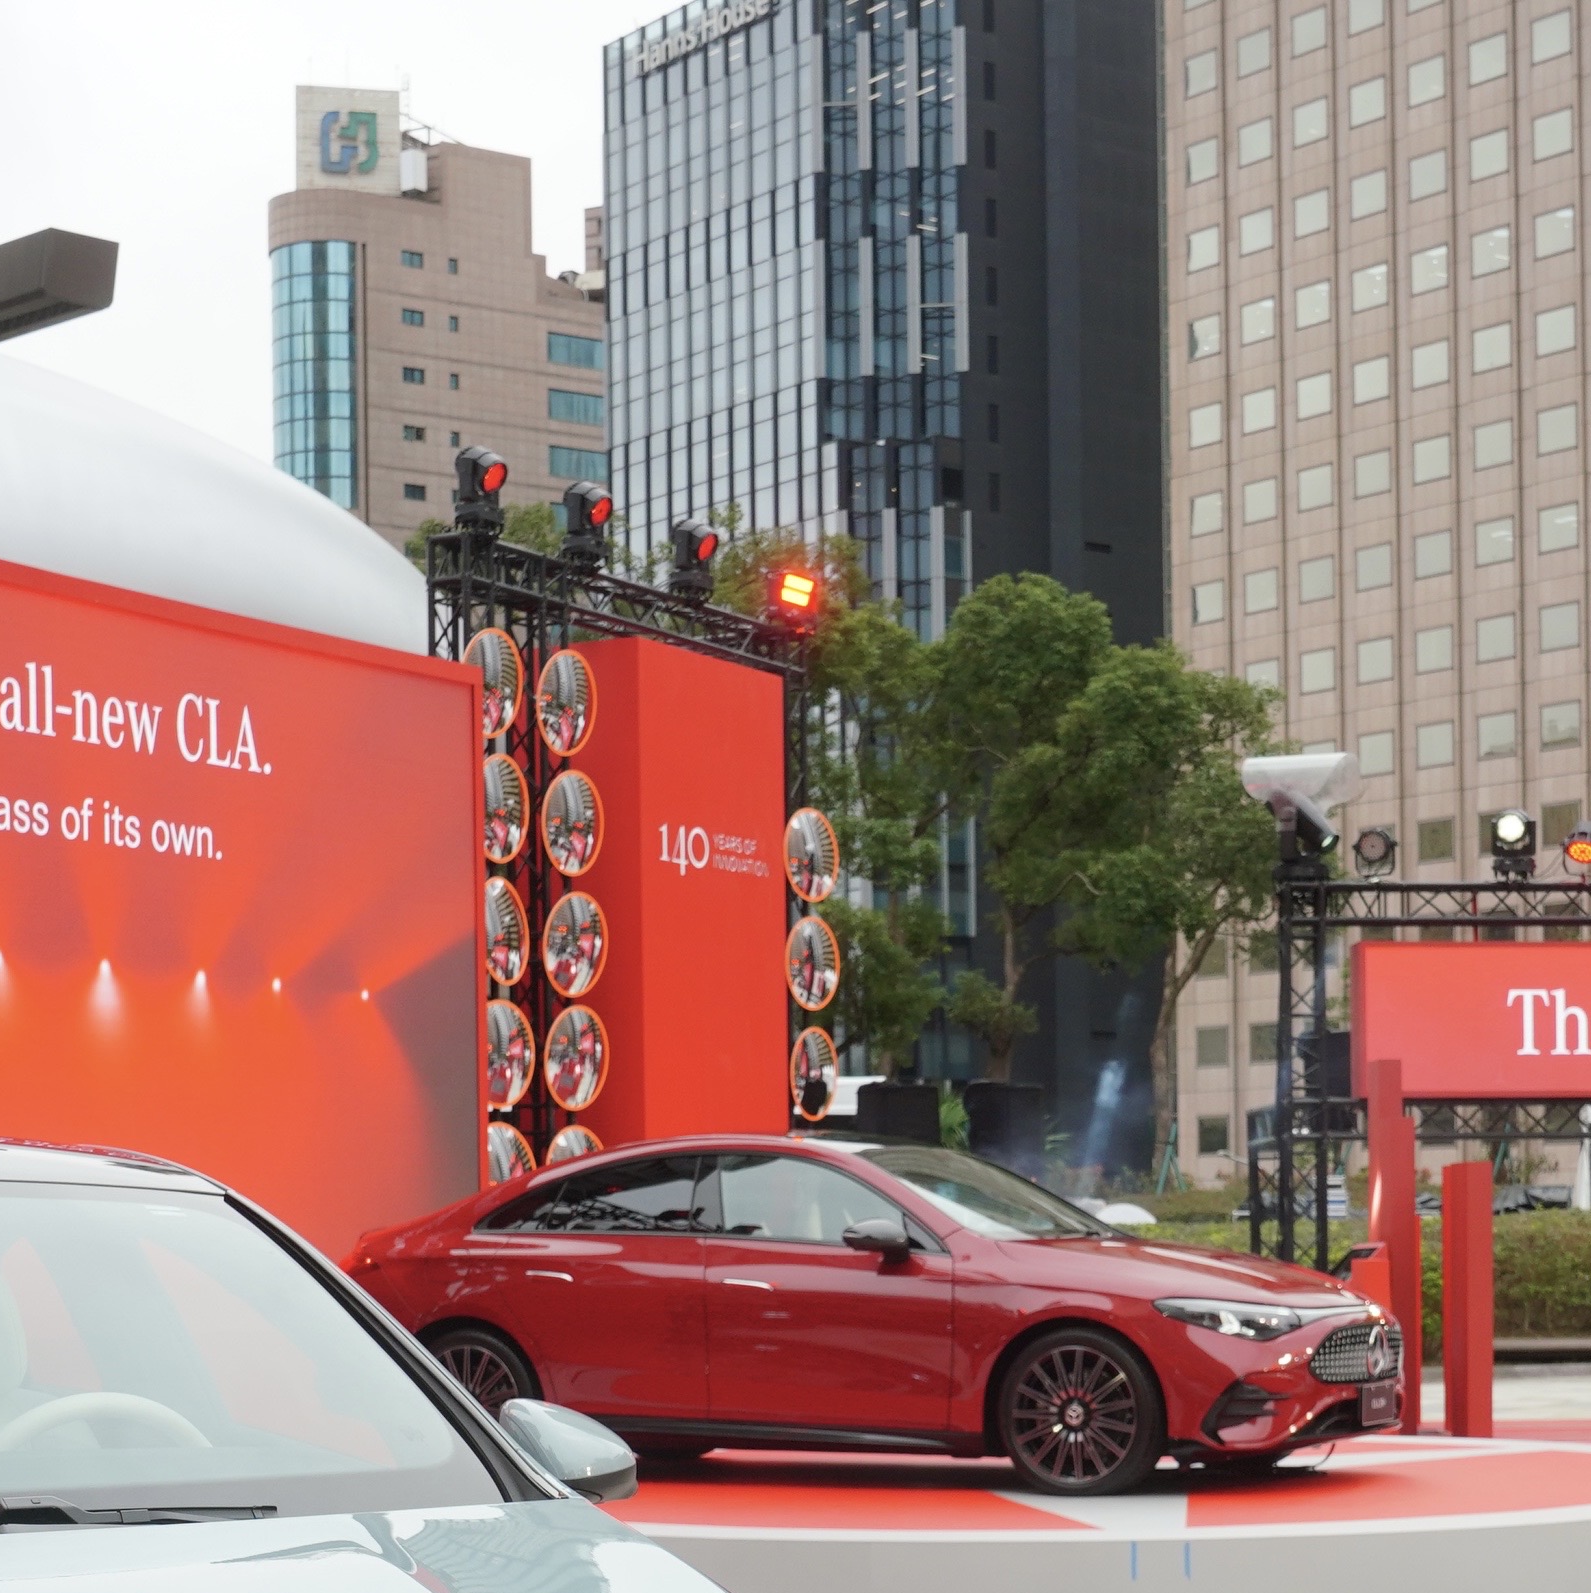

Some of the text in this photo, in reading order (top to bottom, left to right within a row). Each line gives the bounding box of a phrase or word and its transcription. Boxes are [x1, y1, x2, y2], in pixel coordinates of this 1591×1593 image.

[0, 661, 163, 755] all-new
[176, 692, 272, 775] CLA.
[60, 797, 94, 842] of
[102, 800, 141, 849] its
[151, 818, 223, 860] own.
[659, 822, 710, 877] 140
[713, 833, 757, 855] YEARS OF
